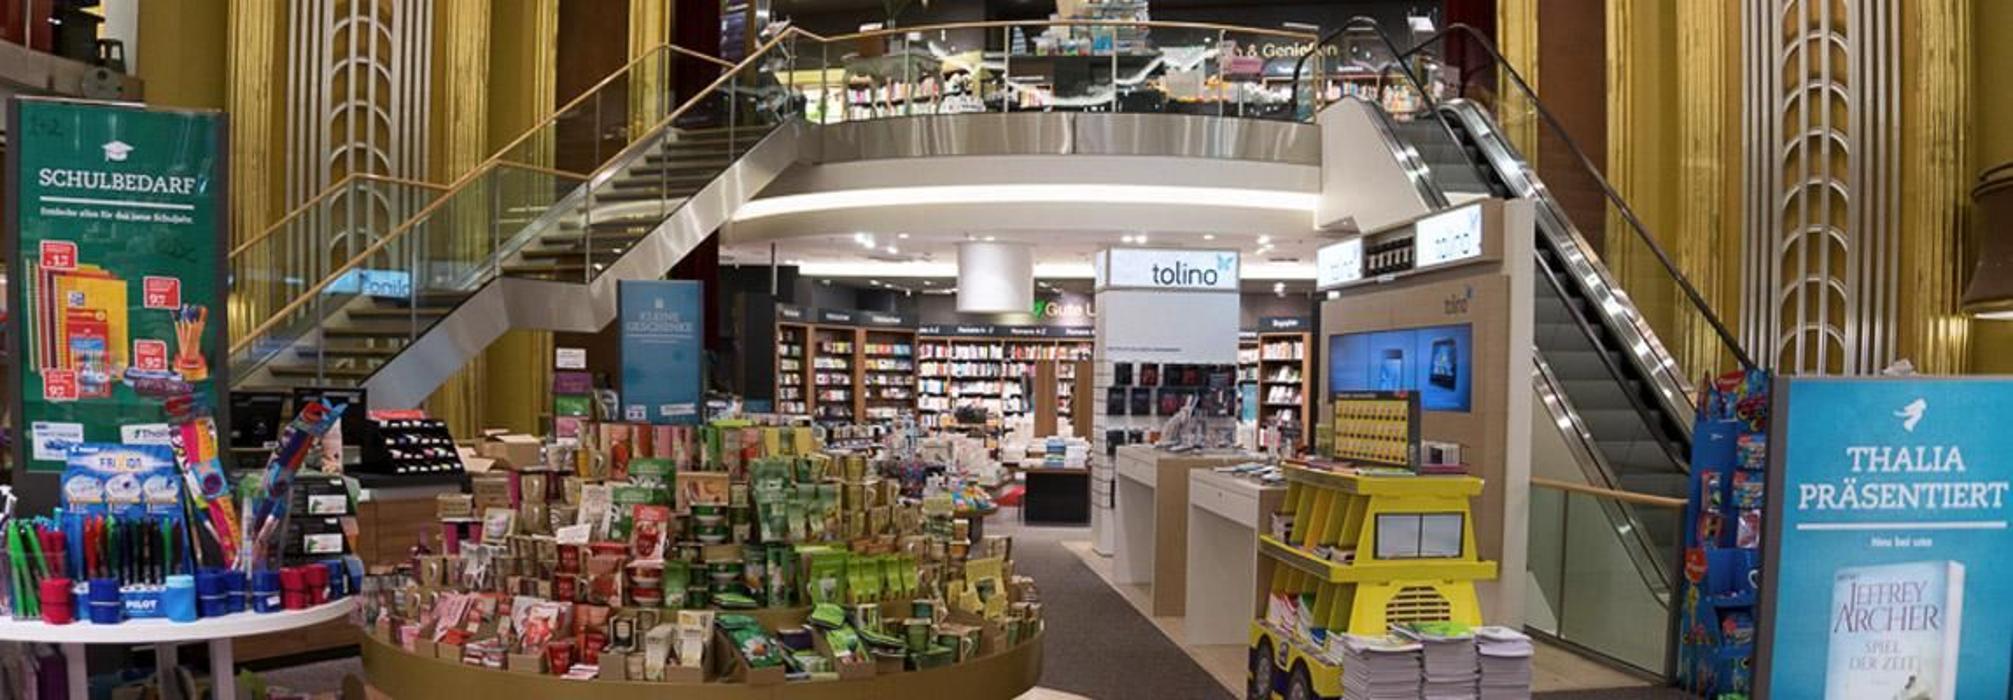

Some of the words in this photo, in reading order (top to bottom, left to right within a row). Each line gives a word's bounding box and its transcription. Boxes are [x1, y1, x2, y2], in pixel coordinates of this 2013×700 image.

[39, 169, 195, 194] SCHULBEDARF
[1153, 259, 1218, 286] tolino
[1045, 302, 1083, 317] Gute
[1846, 447, 1966, 472] THALIA
[1797, 478, 2010, 510] PRÄSENTIERT
[125, 600, 158, 610] PILOT
[1850, 581, 1928, 610] JEFFREY
[1834, 604, 1939, 633] ARCHER
